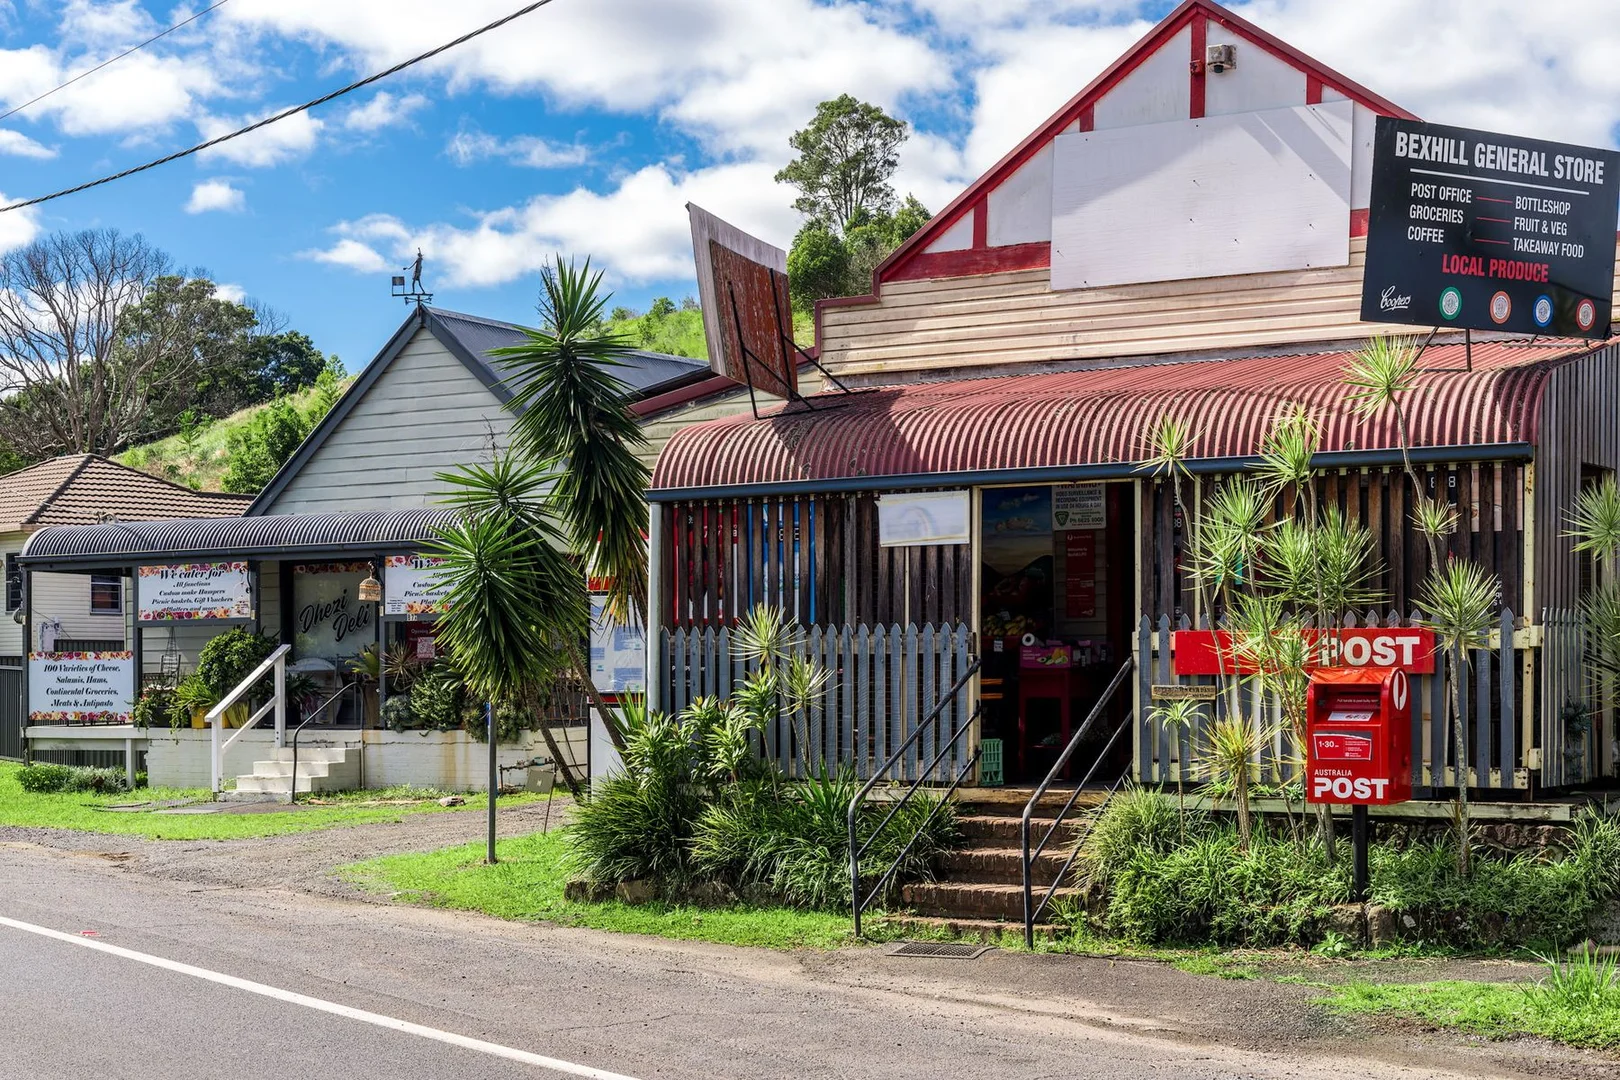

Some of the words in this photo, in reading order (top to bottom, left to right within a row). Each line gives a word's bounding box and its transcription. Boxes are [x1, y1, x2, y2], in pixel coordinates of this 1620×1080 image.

[1395, 131, 1468, 166] BEXHILL
[1474, 142, 1549, 178] GENERAL
[1553, 154, 1604, 184] STORE
[1410, 182, 1438, 200] POST
[1439, 186, 1472, 204] OFFICE
[1410, 204, 1464, 224] GROCERIES
[1515, 196, 1571, 216] BOTTLESHOP
[1408, 226, 1444, 243] COFFEE
[1514, 217, 1540, 233] FRUIT
[1541, 221, 1548, 234] &
[1550, 222, 1568, 236] VEG
[1513, 238, 1560, 256] TAKEAWAY
[1561, 243, 1584, 258] FOOD
[1442, 254, 1485, 277] LOCAL
[1488, 258, 1549, 282] PRODUCE
[160, 569, 177, 579] We
[179, 569, 206, 579] cater
[206, 568, 224, 580] for
[198, 588, 226, 596] Hampers
[300, 588, 348, 634] Dhezi
[333, 604, 370, 642] Deli
[1321, 636, 1420, 666] POST
[89, 664, 97, 674] of
[73, 700, 79, 708] &
[80, 699, 114, 708] Antipasto
[1314, 769, 1352, 777] AUSTRALIA
[1314, 778, 1389, 800] POST
